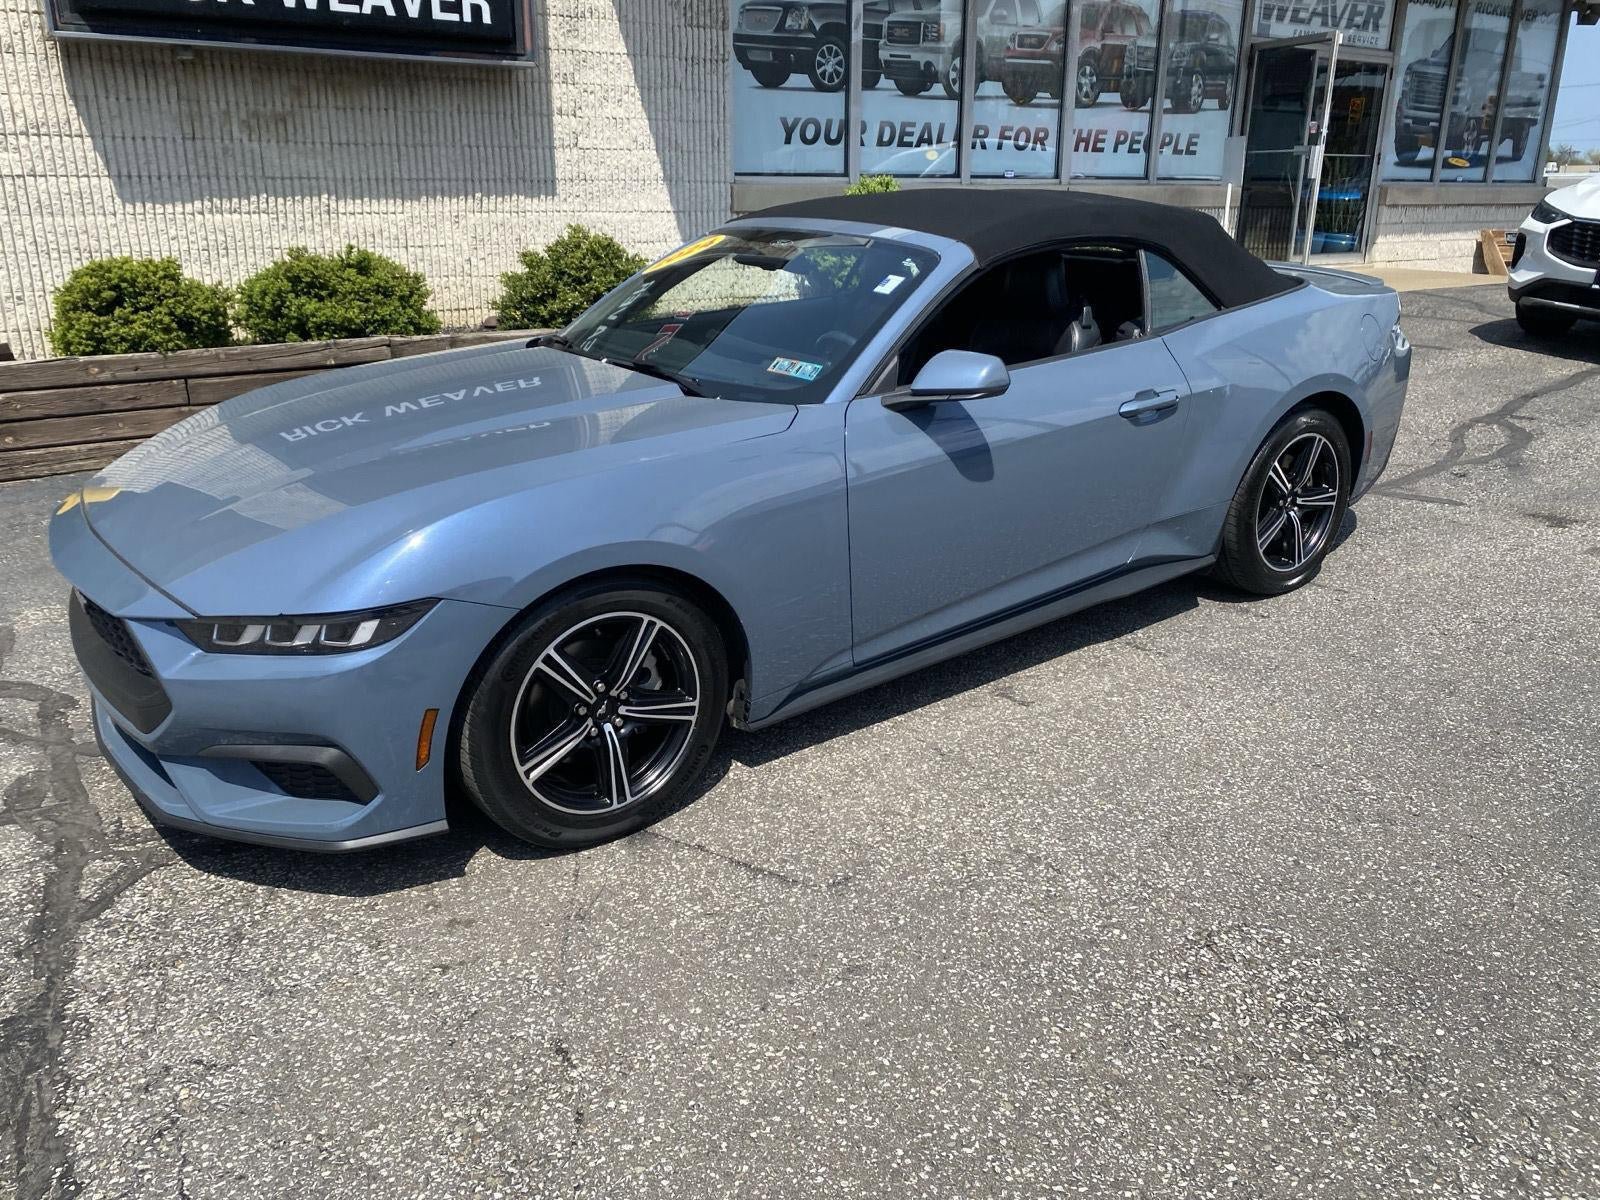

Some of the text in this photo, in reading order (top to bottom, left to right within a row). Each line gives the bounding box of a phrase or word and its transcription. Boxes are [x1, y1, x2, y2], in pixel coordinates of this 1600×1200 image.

[1347, 34, 1379, 45] SERVICE
[875, 120, 990, 151] DEALR
[996, 125, 1051, 152] FOR
[1072, 128, 1108, 153] HE
